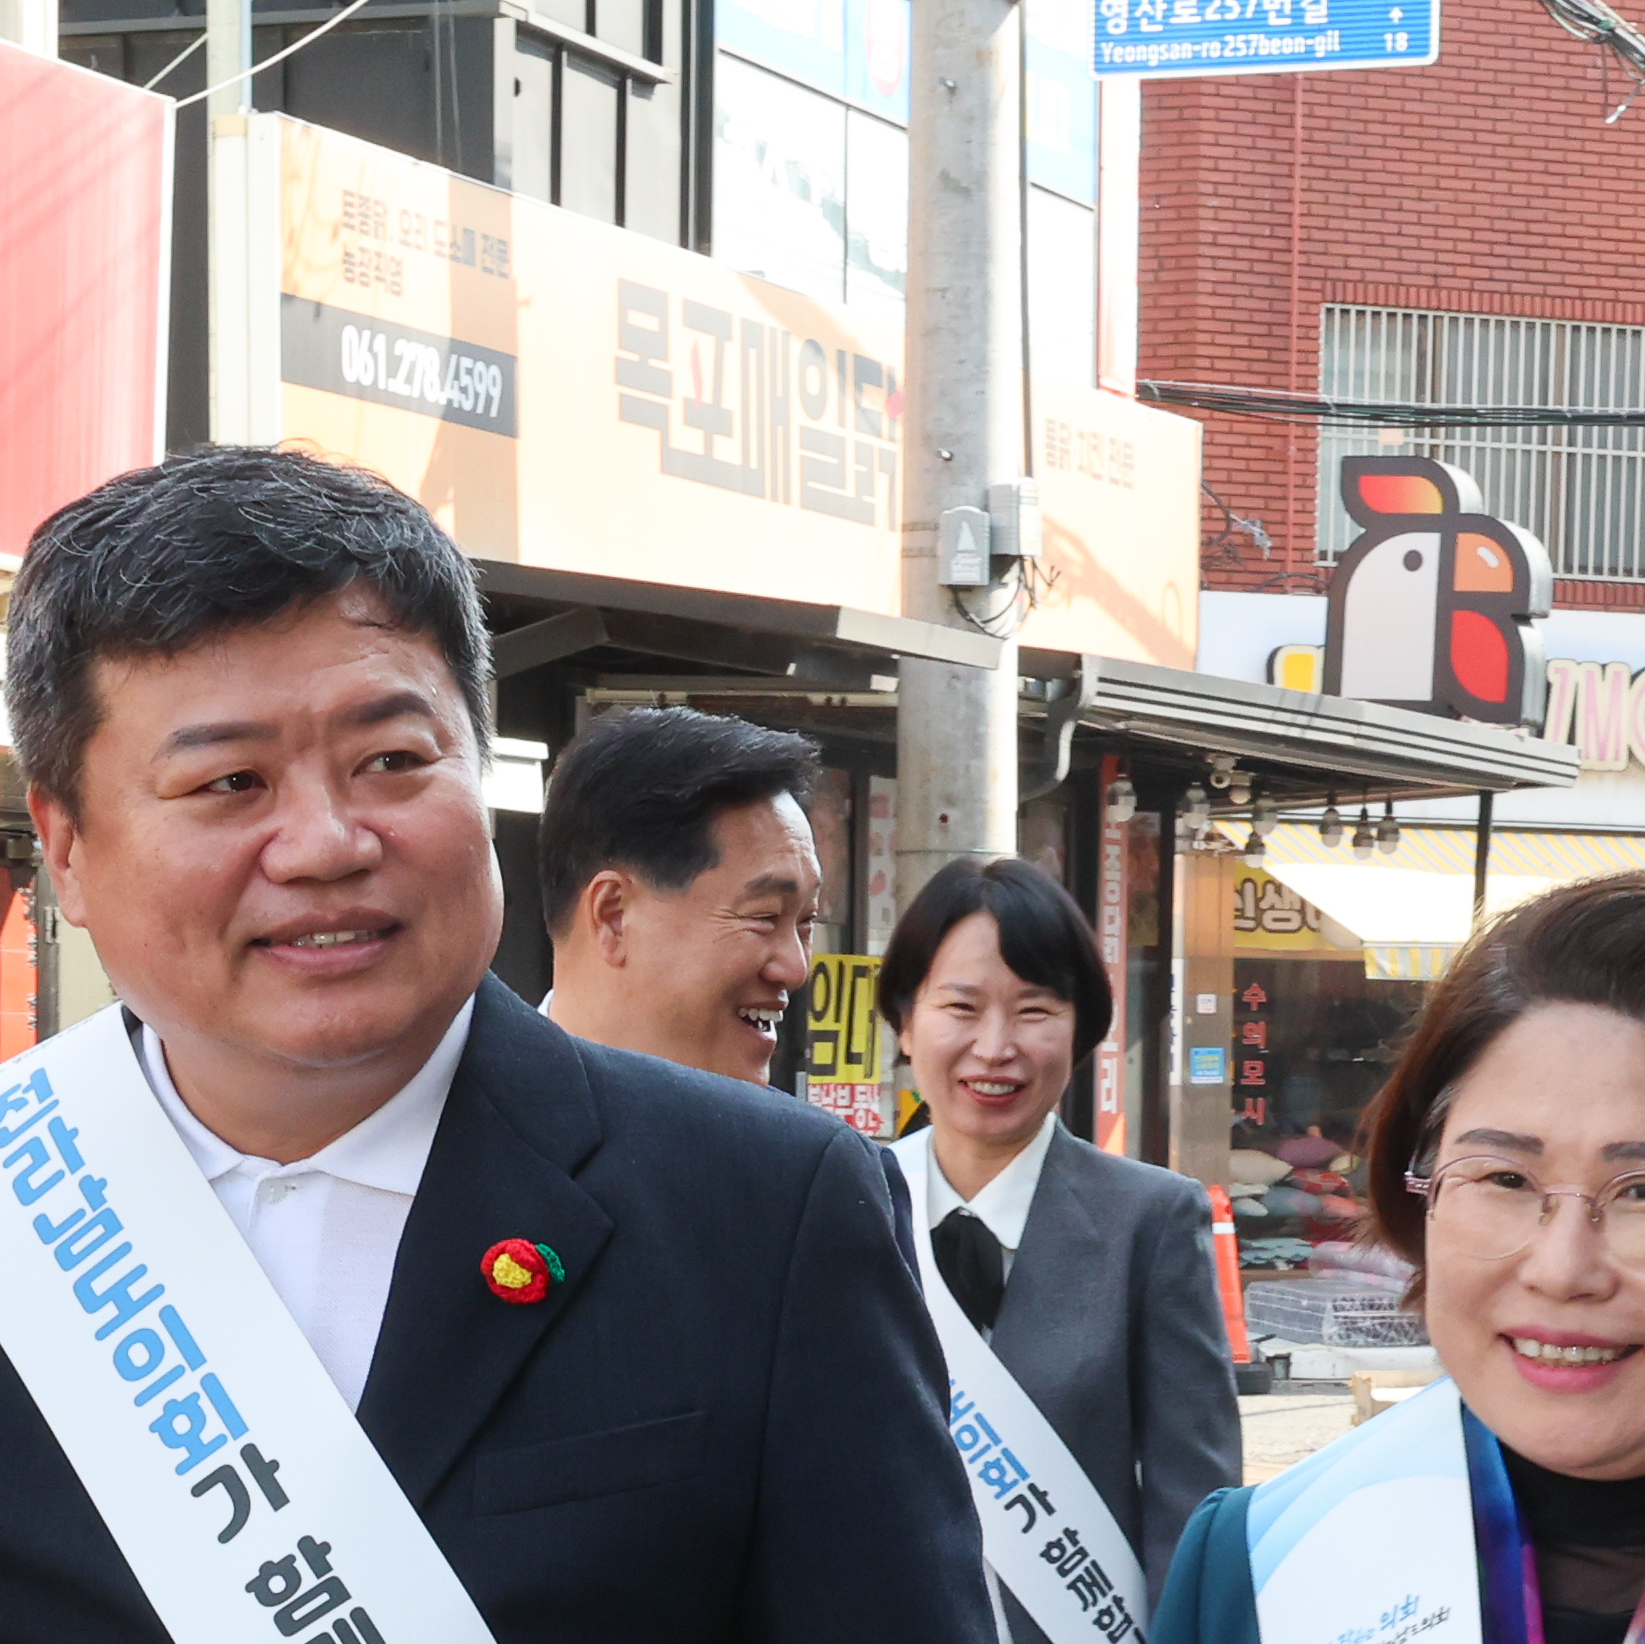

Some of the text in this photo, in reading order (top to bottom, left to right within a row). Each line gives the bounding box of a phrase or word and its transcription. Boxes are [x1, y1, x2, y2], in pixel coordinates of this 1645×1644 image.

[1384, 32, 1408, 52] 18
[340, 322, 502, 420] 061.278.4599
[809, 960, 884, 1080] 임대
[1379, 1593, 1420, 1632] 의회
